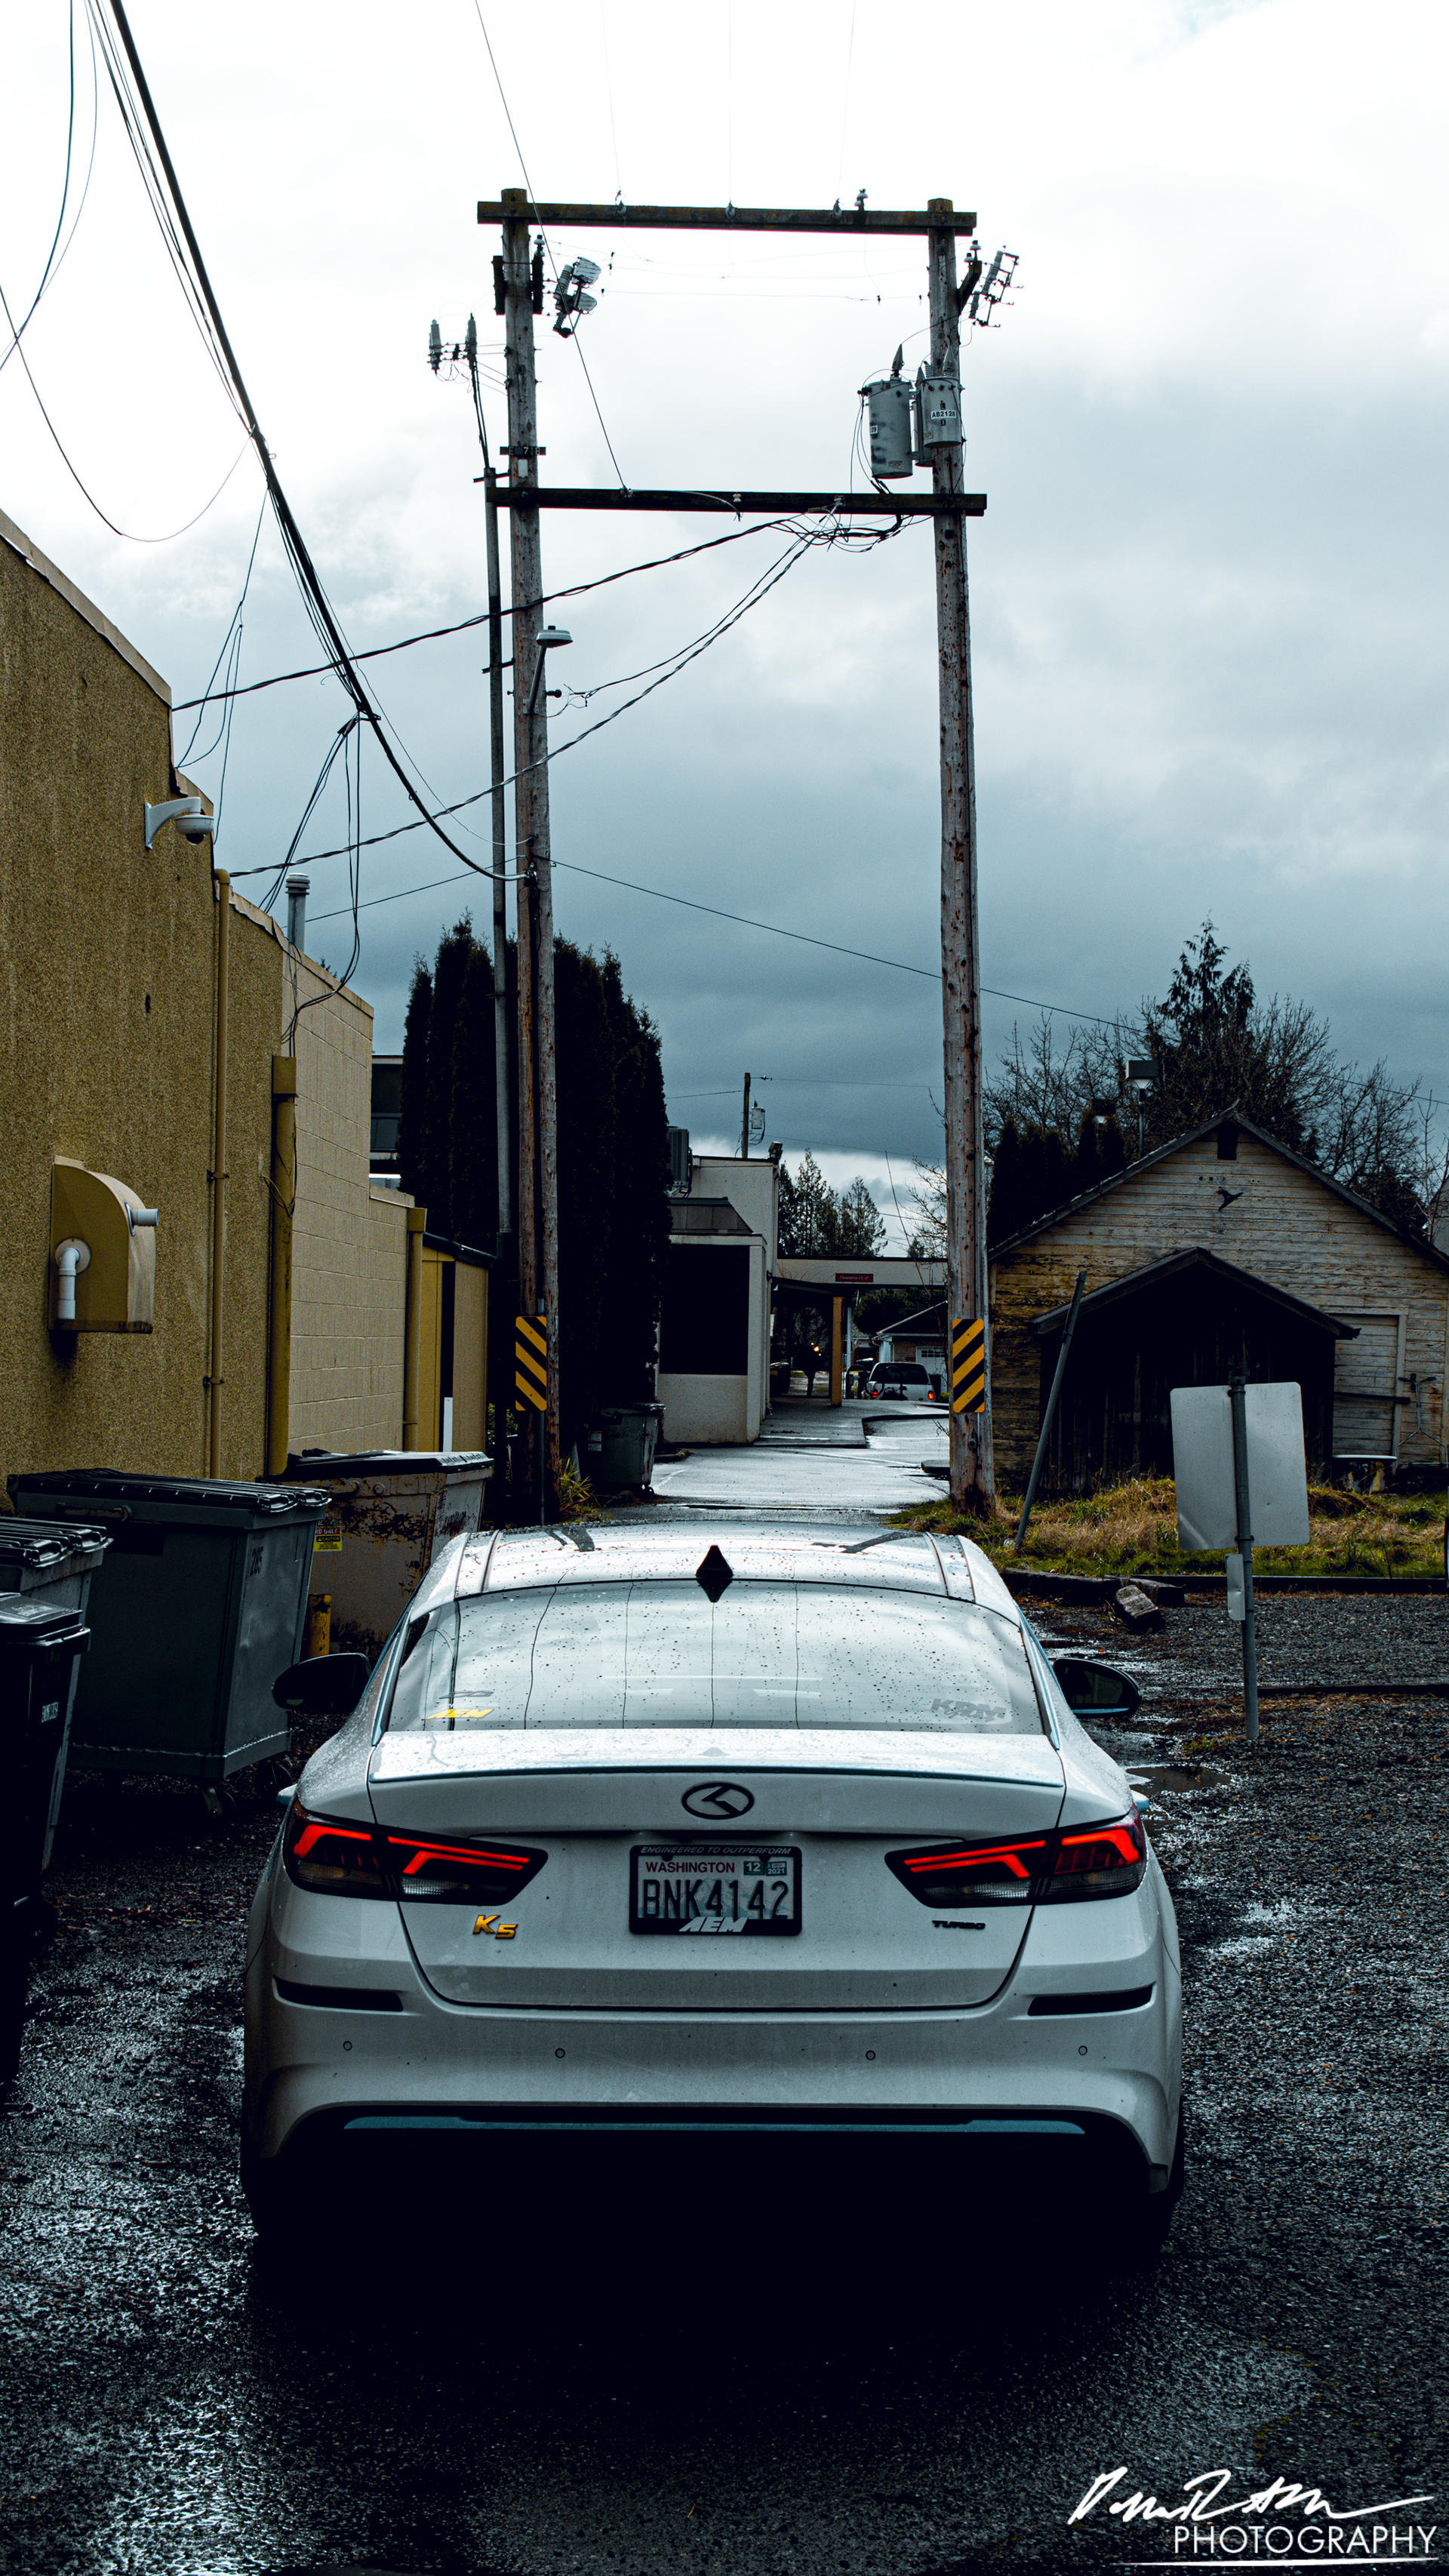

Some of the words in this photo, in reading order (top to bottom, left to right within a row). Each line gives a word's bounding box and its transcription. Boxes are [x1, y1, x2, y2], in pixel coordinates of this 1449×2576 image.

[931, 411, 955, 419] AB2128
[425, 1709, 494, 1719] AEM
[645, 1861, 735, 1873] WASHINGTON
[746, 1862, 761, 1872] 12
[643, 1879, 789, 1919] BNK4142
[472, 1914, 518, 1939] K5
[678, 1916, 749, 1932] AEM
[931, 1920, 986, 1930] TURBO
